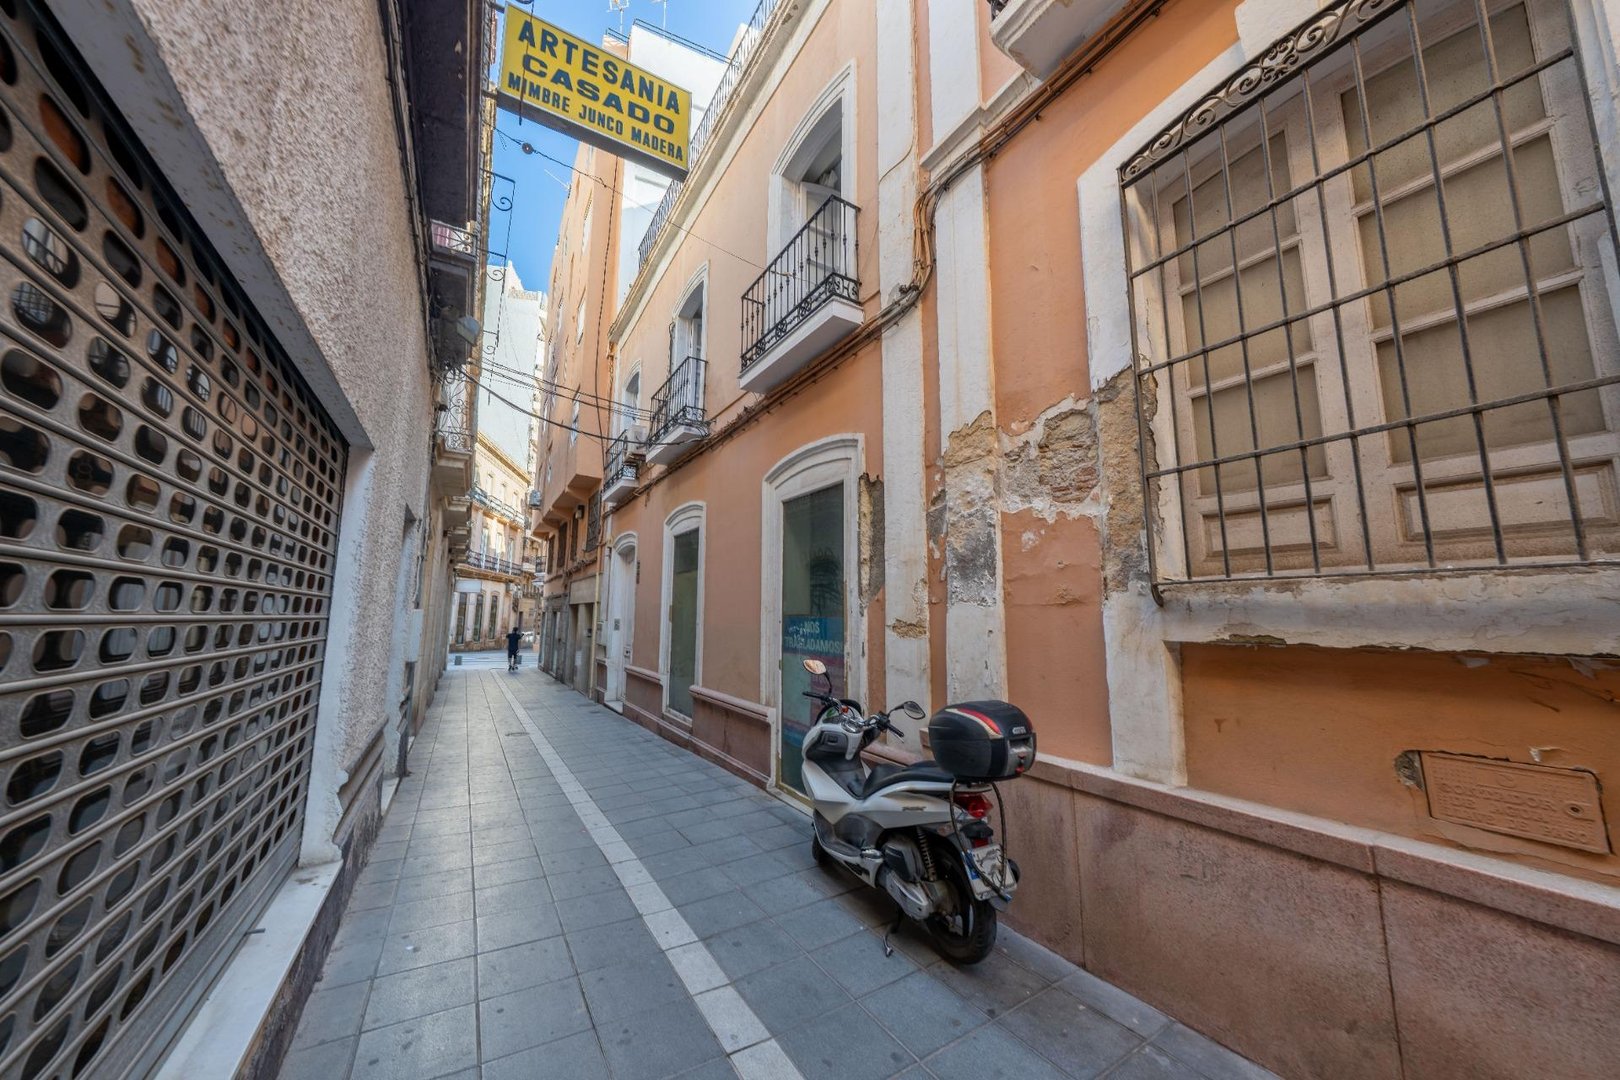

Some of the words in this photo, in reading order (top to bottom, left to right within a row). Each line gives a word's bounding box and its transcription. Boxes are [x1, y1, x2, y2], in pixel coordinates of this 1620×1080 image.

[518, 20, 680, 115] ARTESANIA
[523, 54, 675, 134] CASADO
[508, 72, 570, 113] MIMBRE
[578, 104, 623, 136] JUNCO
[631, 126, 683, 162] MADERA
